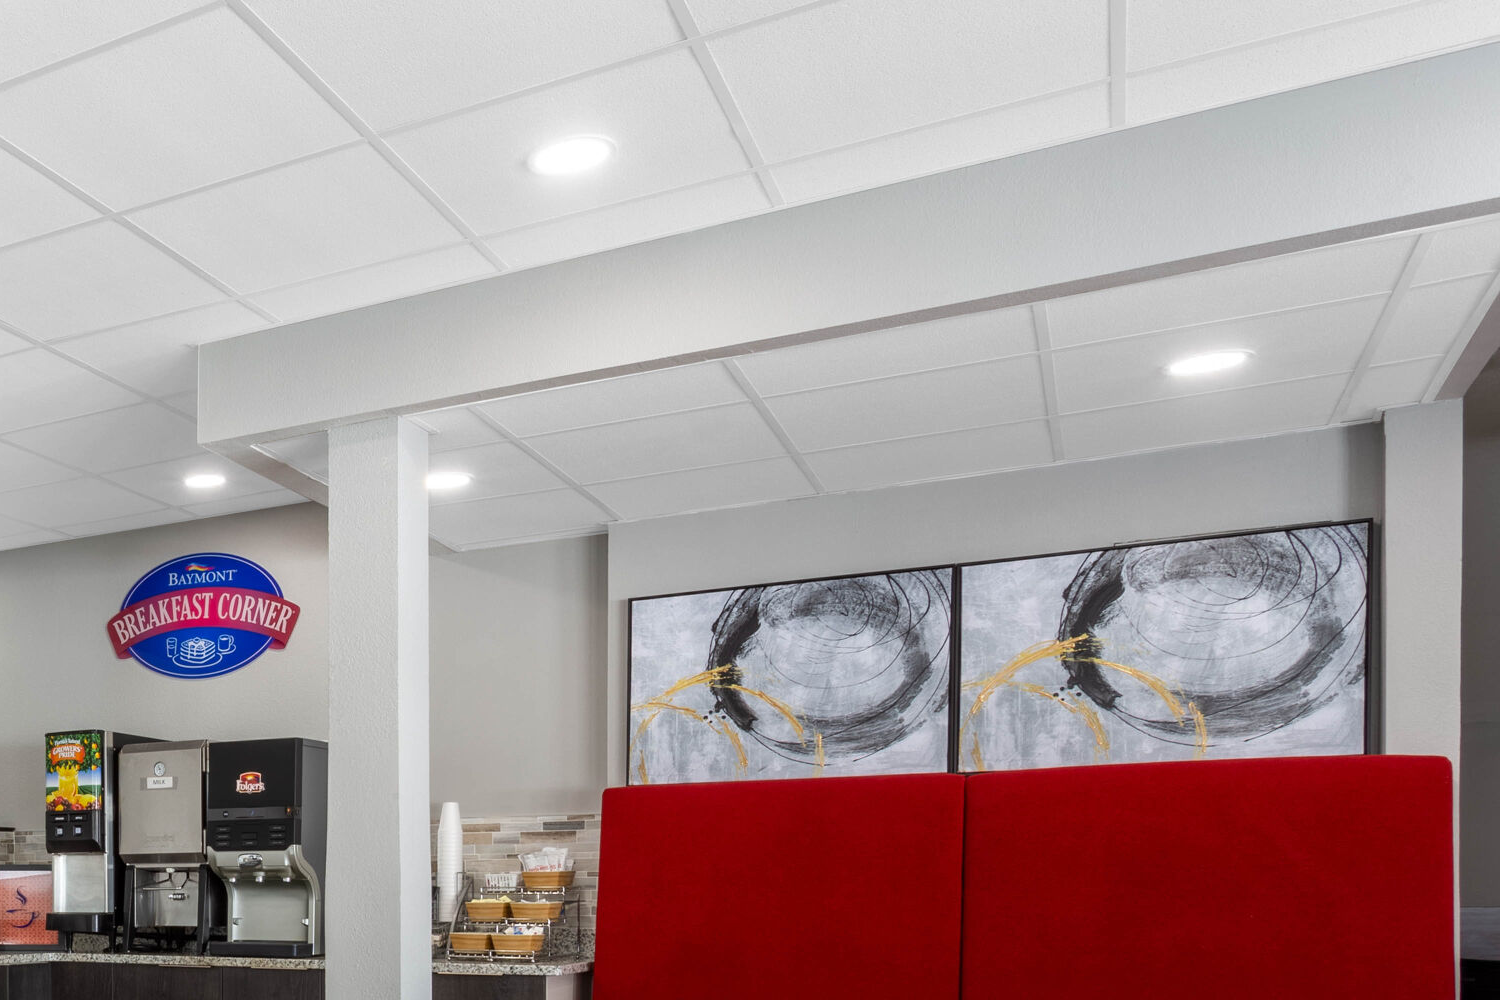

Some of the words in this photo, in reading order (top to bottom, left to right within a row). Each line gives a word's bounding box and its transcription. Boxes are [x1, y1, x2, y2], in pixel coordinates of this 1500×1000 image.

[168, 569, 235, 586] BAYMONT
[112, 592, 213, 645] BREAKFAST
[217, 592, 293, 634] CORNER
